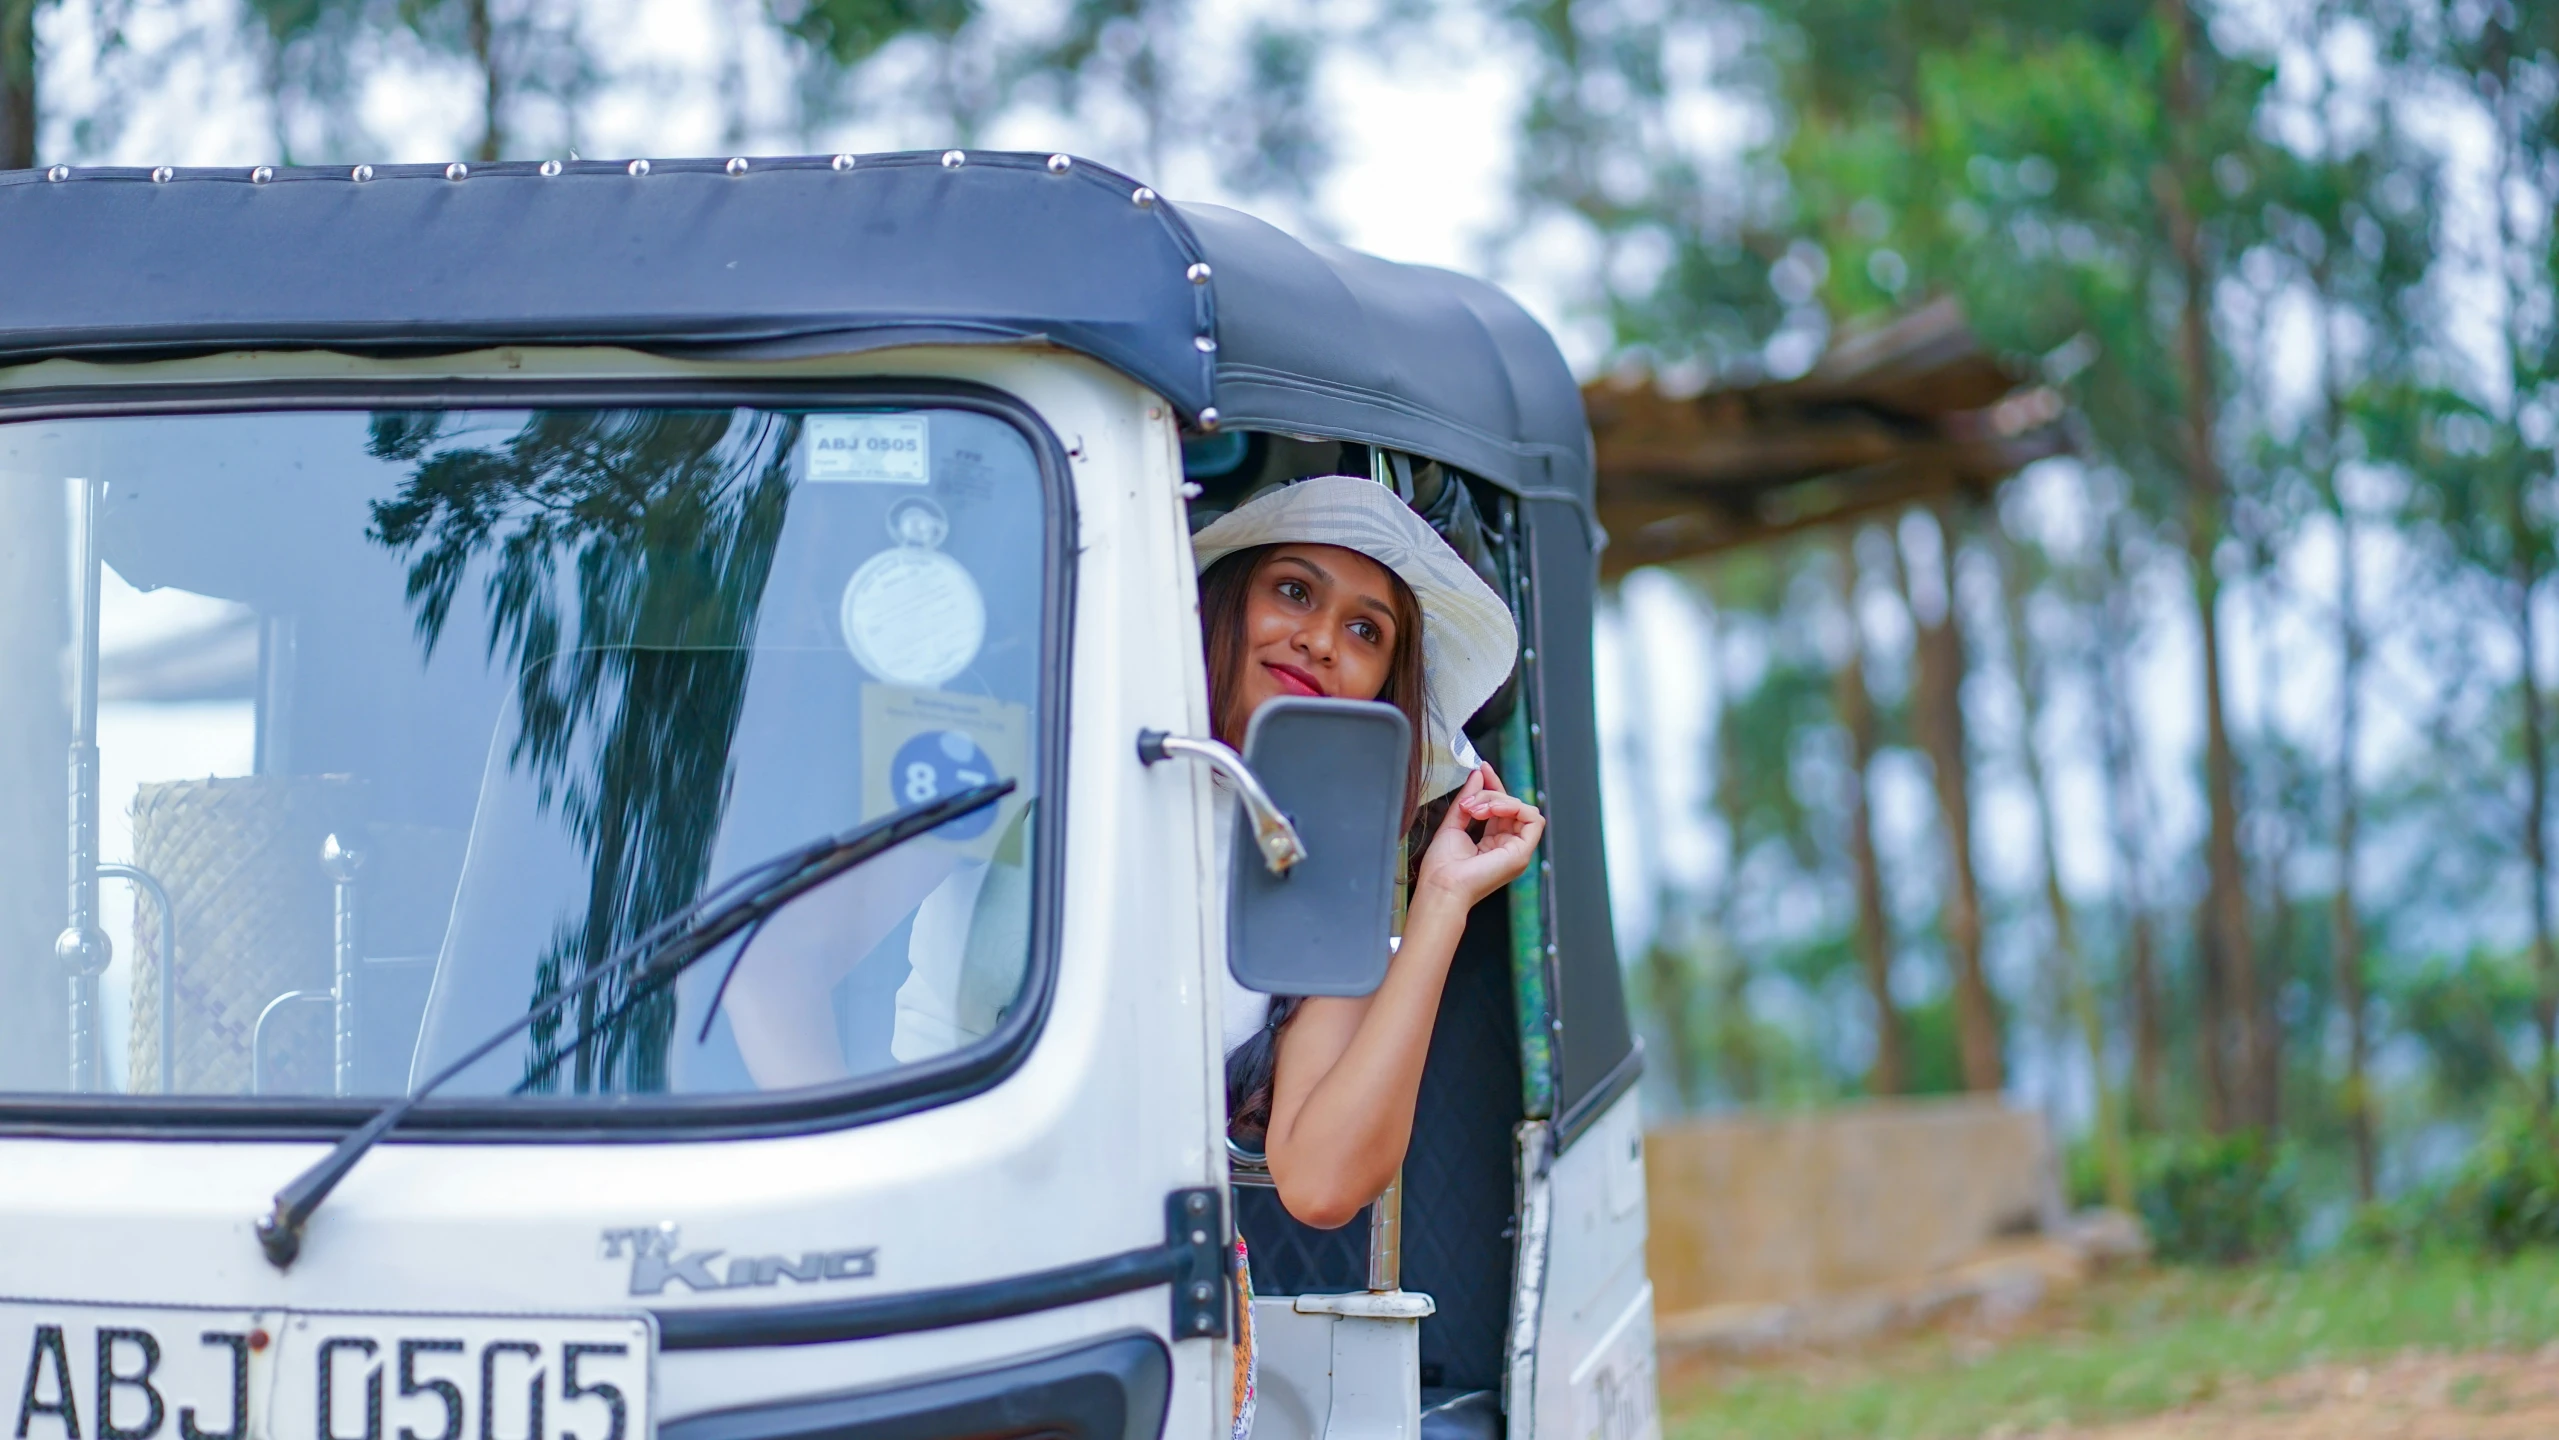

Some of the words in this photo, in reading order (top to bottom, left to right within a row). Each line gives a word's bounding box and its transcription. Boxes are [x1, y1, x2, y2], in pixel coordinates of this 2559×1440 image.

[816, 437, 860, 452] ABJ
[866, 437, 918, 453] 0505
[629, 1246, 879, 1297] KING
[13, 1324, 252, 1440] ABJ
[316, 1336, 629, 1440] 0505
